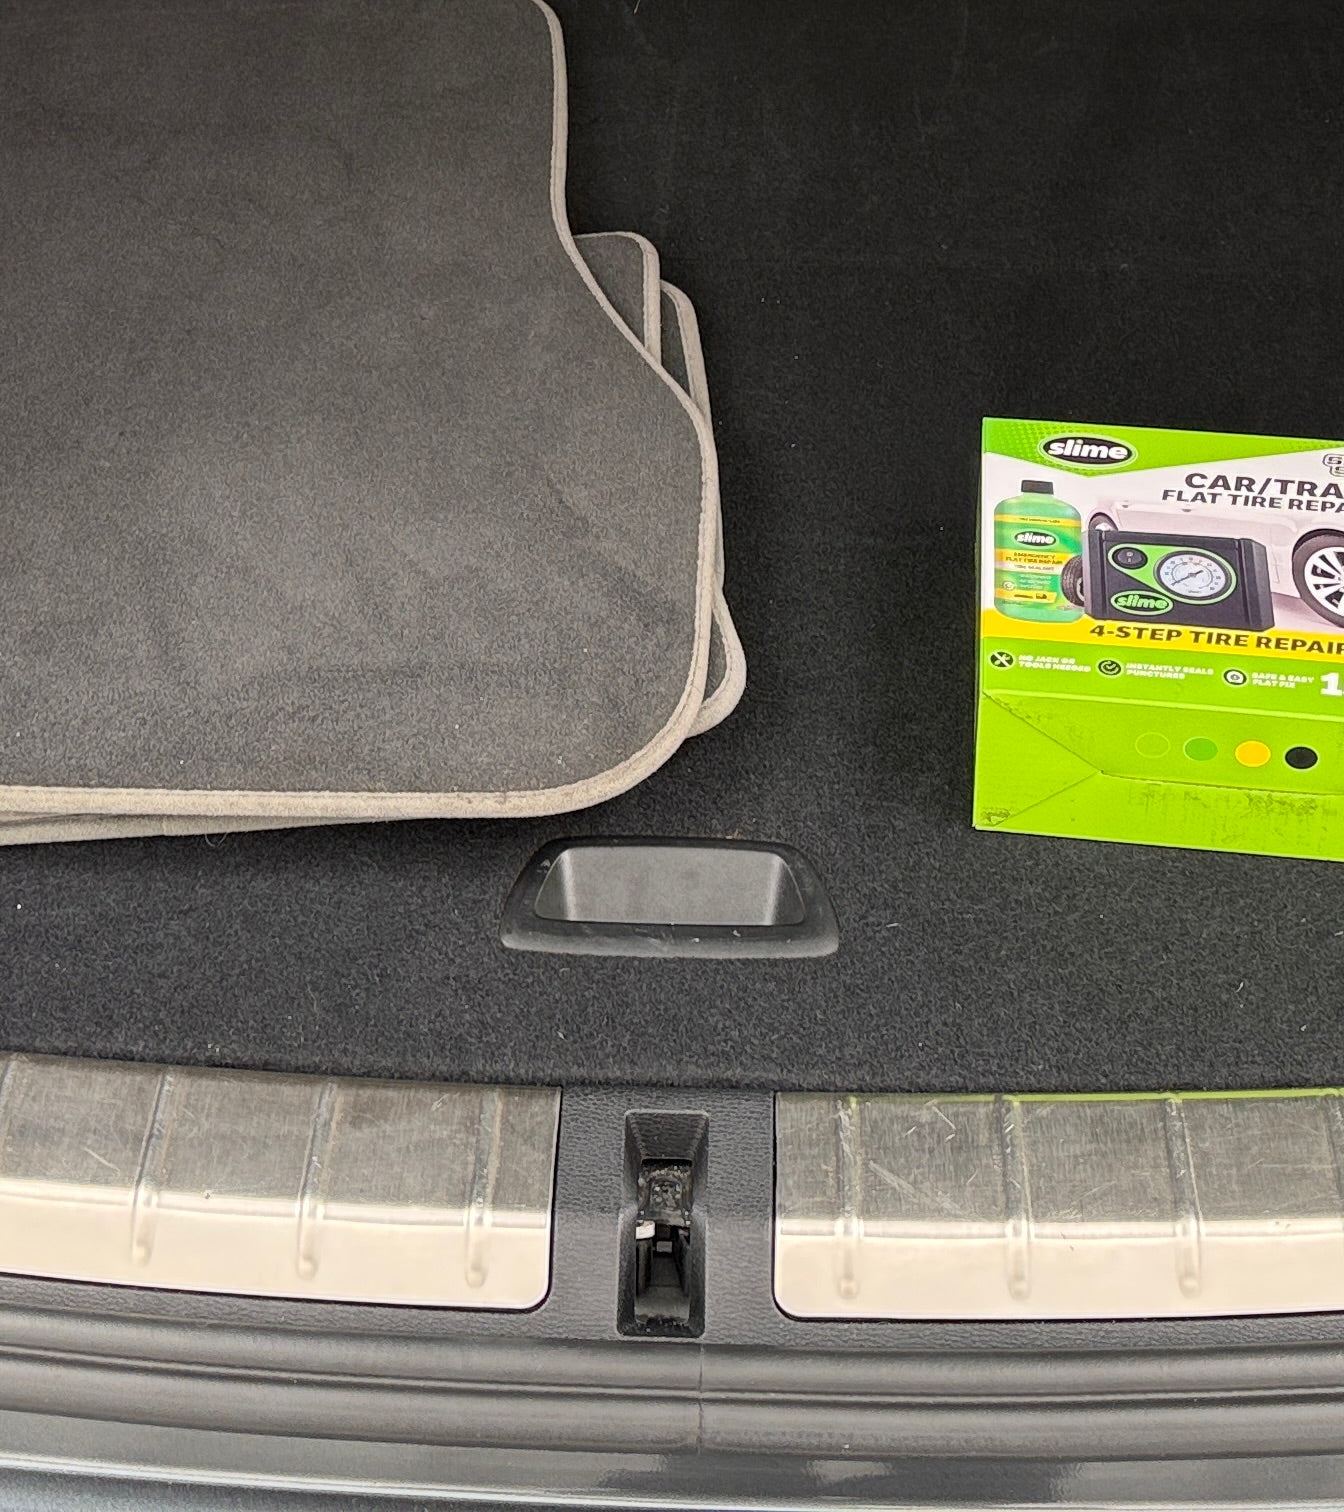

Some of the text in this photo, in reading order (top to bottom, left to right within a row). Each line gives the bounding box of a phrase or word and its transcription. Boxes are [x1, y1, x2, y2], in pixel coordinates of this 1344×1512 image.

[1048, 439, 1128, 460] slime
[1161, 489, 1222, 504] FLAT
[1227, 493, 1282, 509] TIRE
[1016, 532, 1055, 544] slime
[1116, 594, 1168, 609] slime
[1090, 624, 1182, 642] 4-STEP
[1189, 630, 1248, 647] TIRE
[1126, 662, 1214, 676] INSTANTLY SEALS
